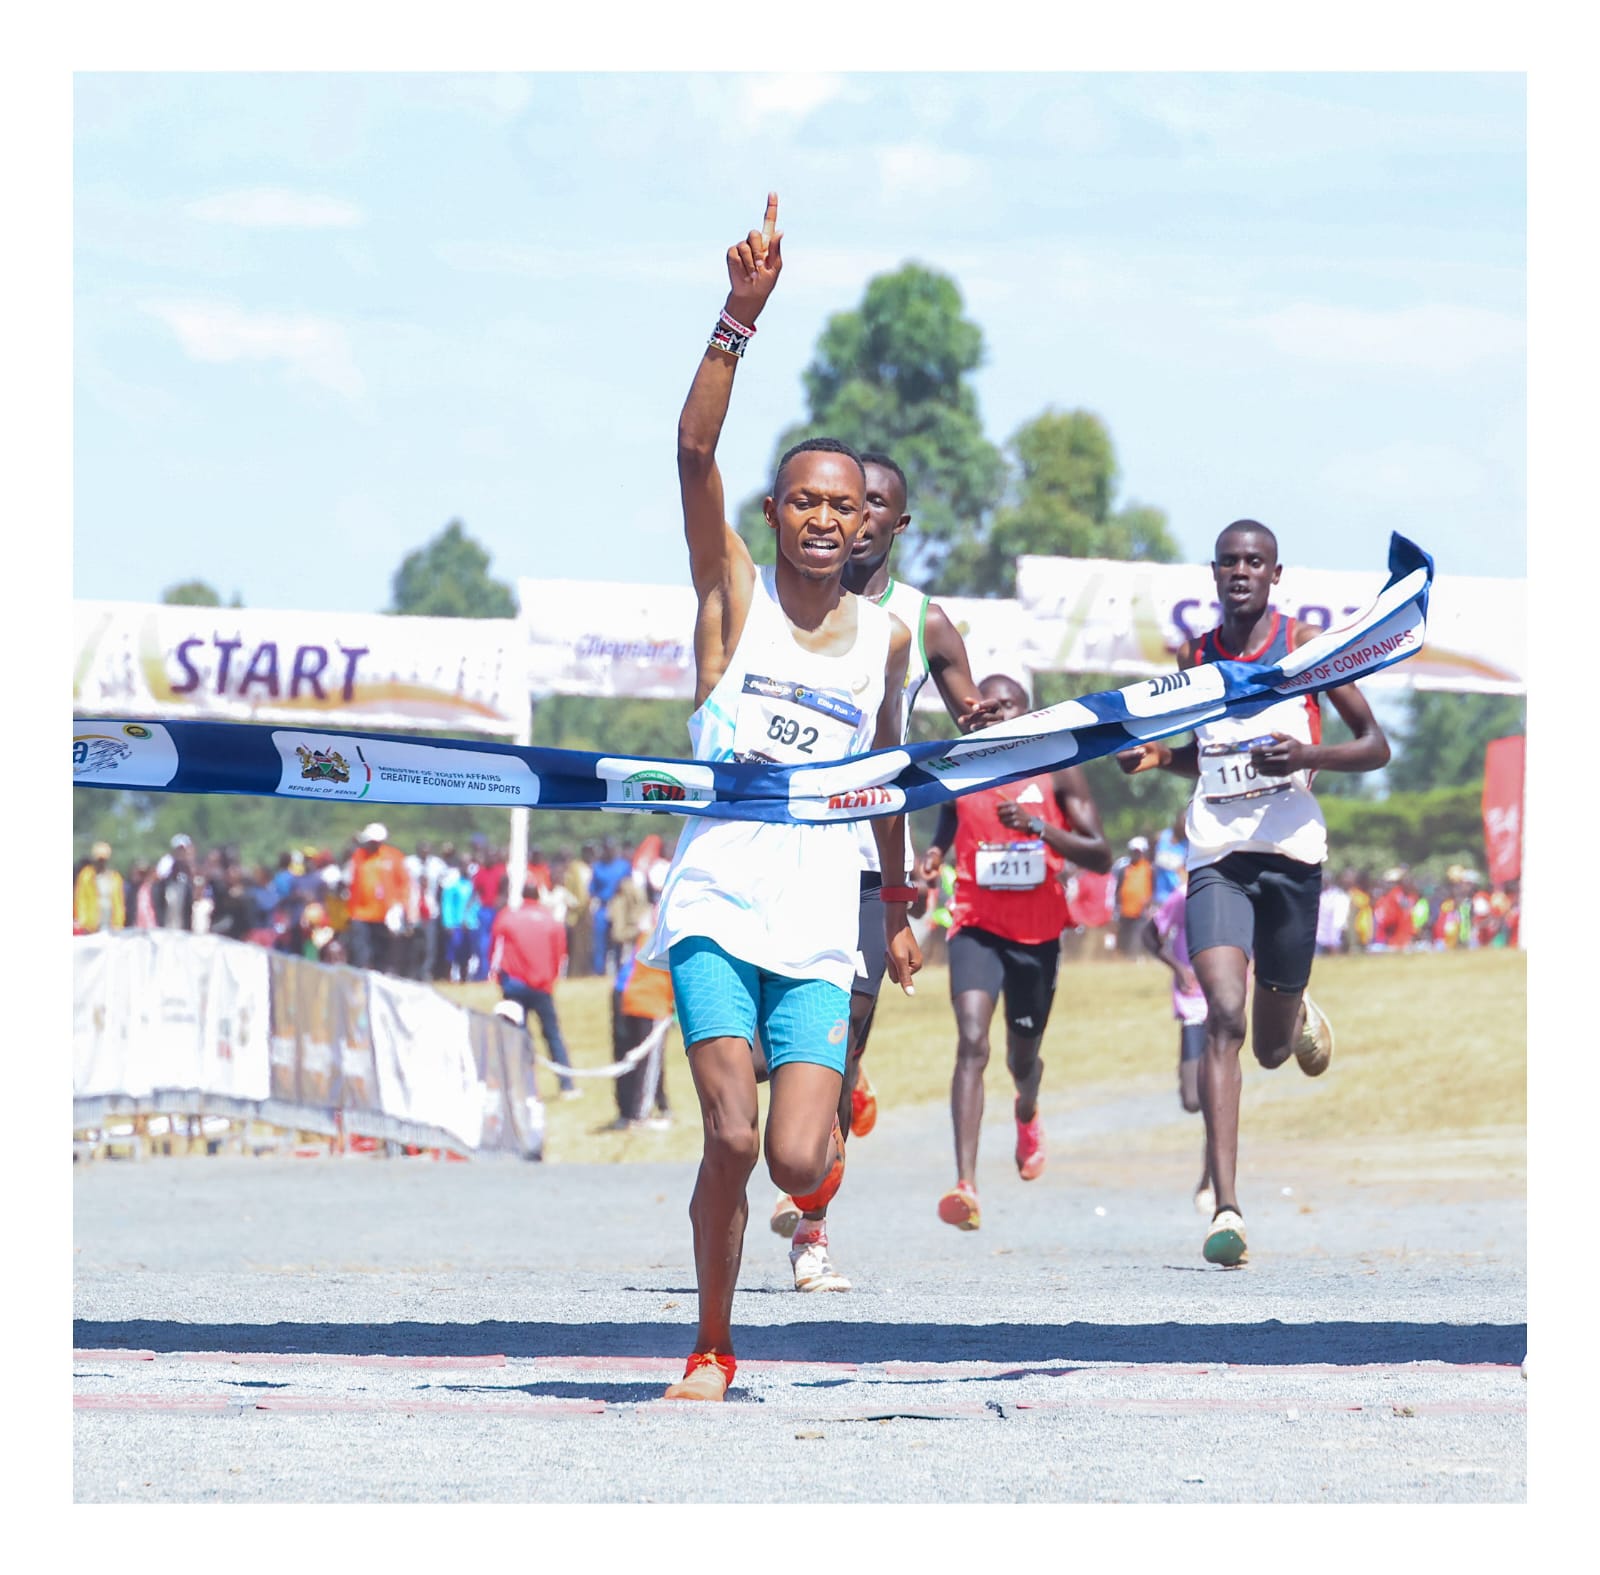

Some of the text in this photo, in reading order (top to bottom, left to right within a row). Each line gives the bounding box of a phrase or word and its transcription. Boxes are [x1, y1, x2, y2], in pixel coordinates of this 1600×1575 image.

[1314, 663, 1333, 680] OF
[1332, 629, 1416, 673] COMPANIES
[170, 637, 371, 702] START
[766, 714, 819, 755] 692
[380, 772, 521, 795] CREATIVE ECONOMY AND SPORTS
[465, 773, 502, 782] AFFAIRS
[1217, 763, 1257, 785] 110
[288, 784, 322, 793] REPUBLIC
[991, 860, 1031, 876] 1211
